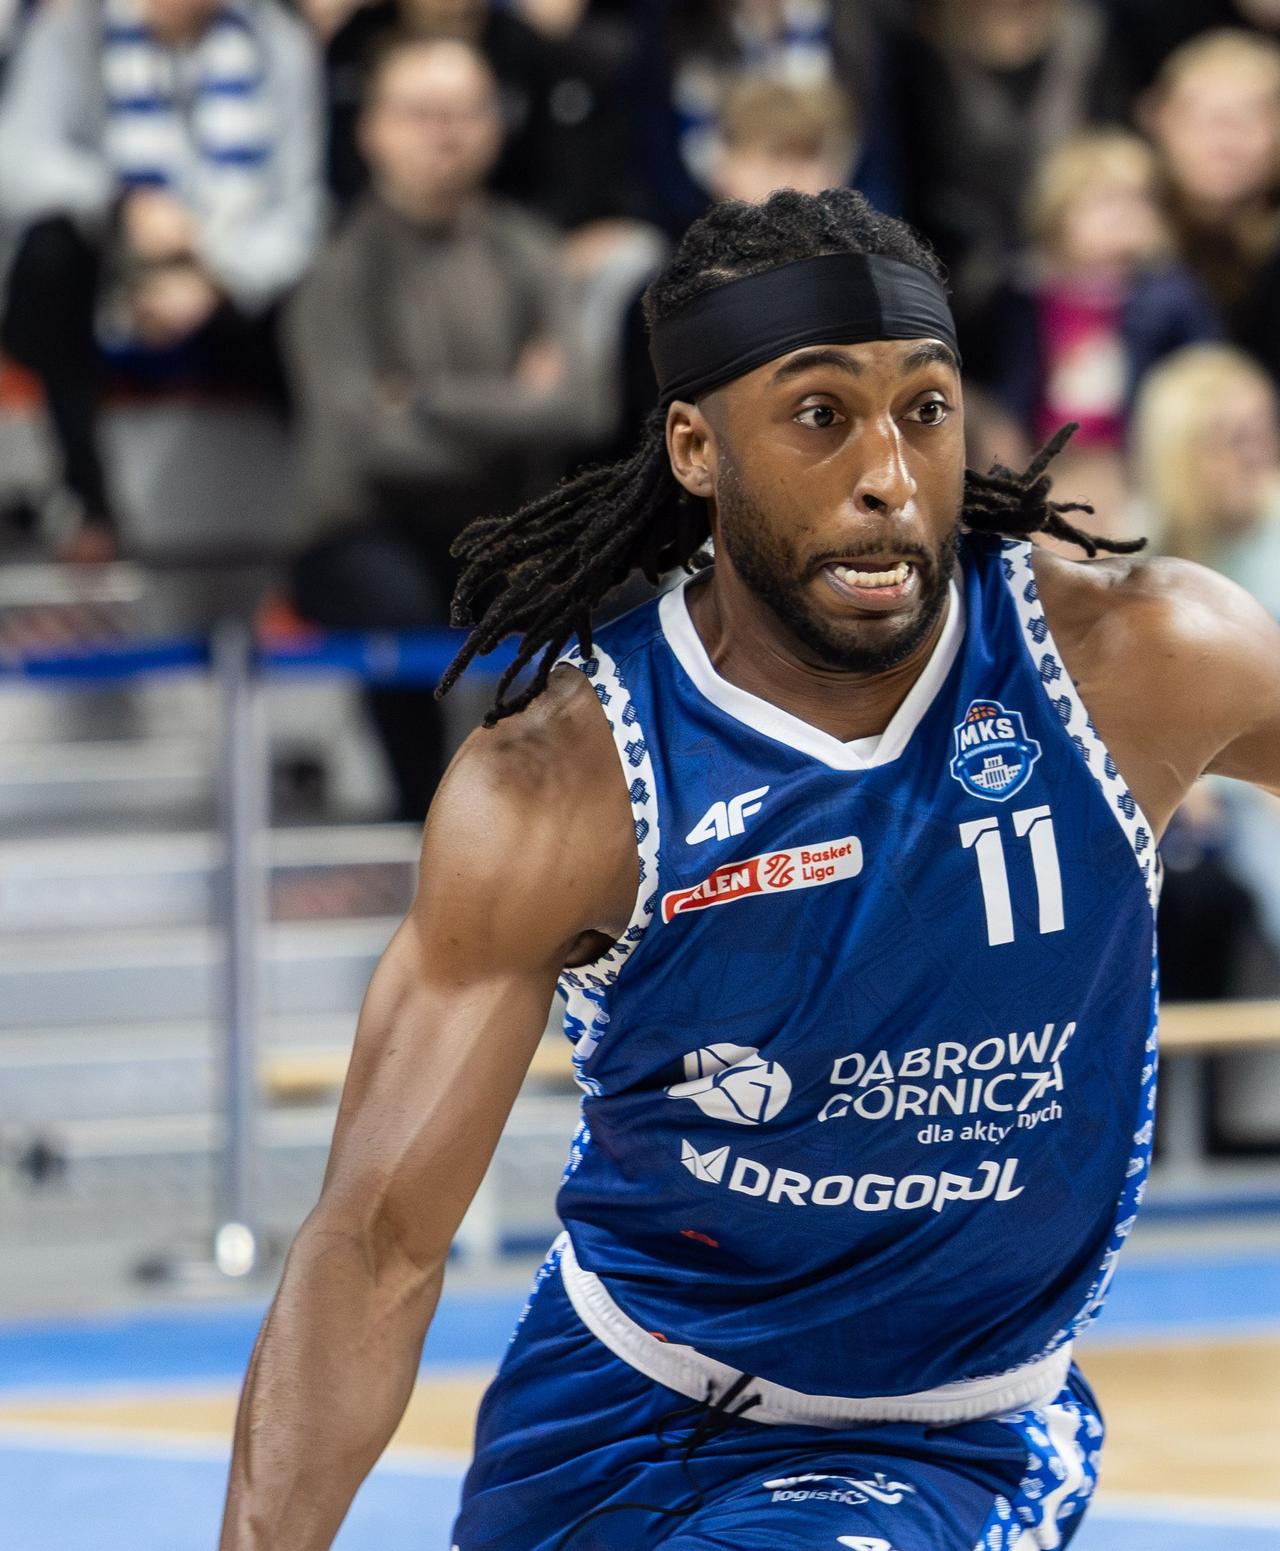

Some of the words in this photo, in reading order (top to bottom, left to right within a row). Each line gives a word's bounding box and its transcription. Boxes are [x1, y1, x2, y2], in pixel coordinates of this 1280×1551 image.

[960, 718, 1016, 751] MKS
[685, 785, 770, 845] 4F
[800, 843, 852, 865] Basket
[691, 867, 751, 901] LEN
[802, 864, 835, 882] Liga
[959, 805, 1065, 946] 11
[917, 1123, 954, 1145] dla
[960, 1100, 1063, 1145] aktynych
